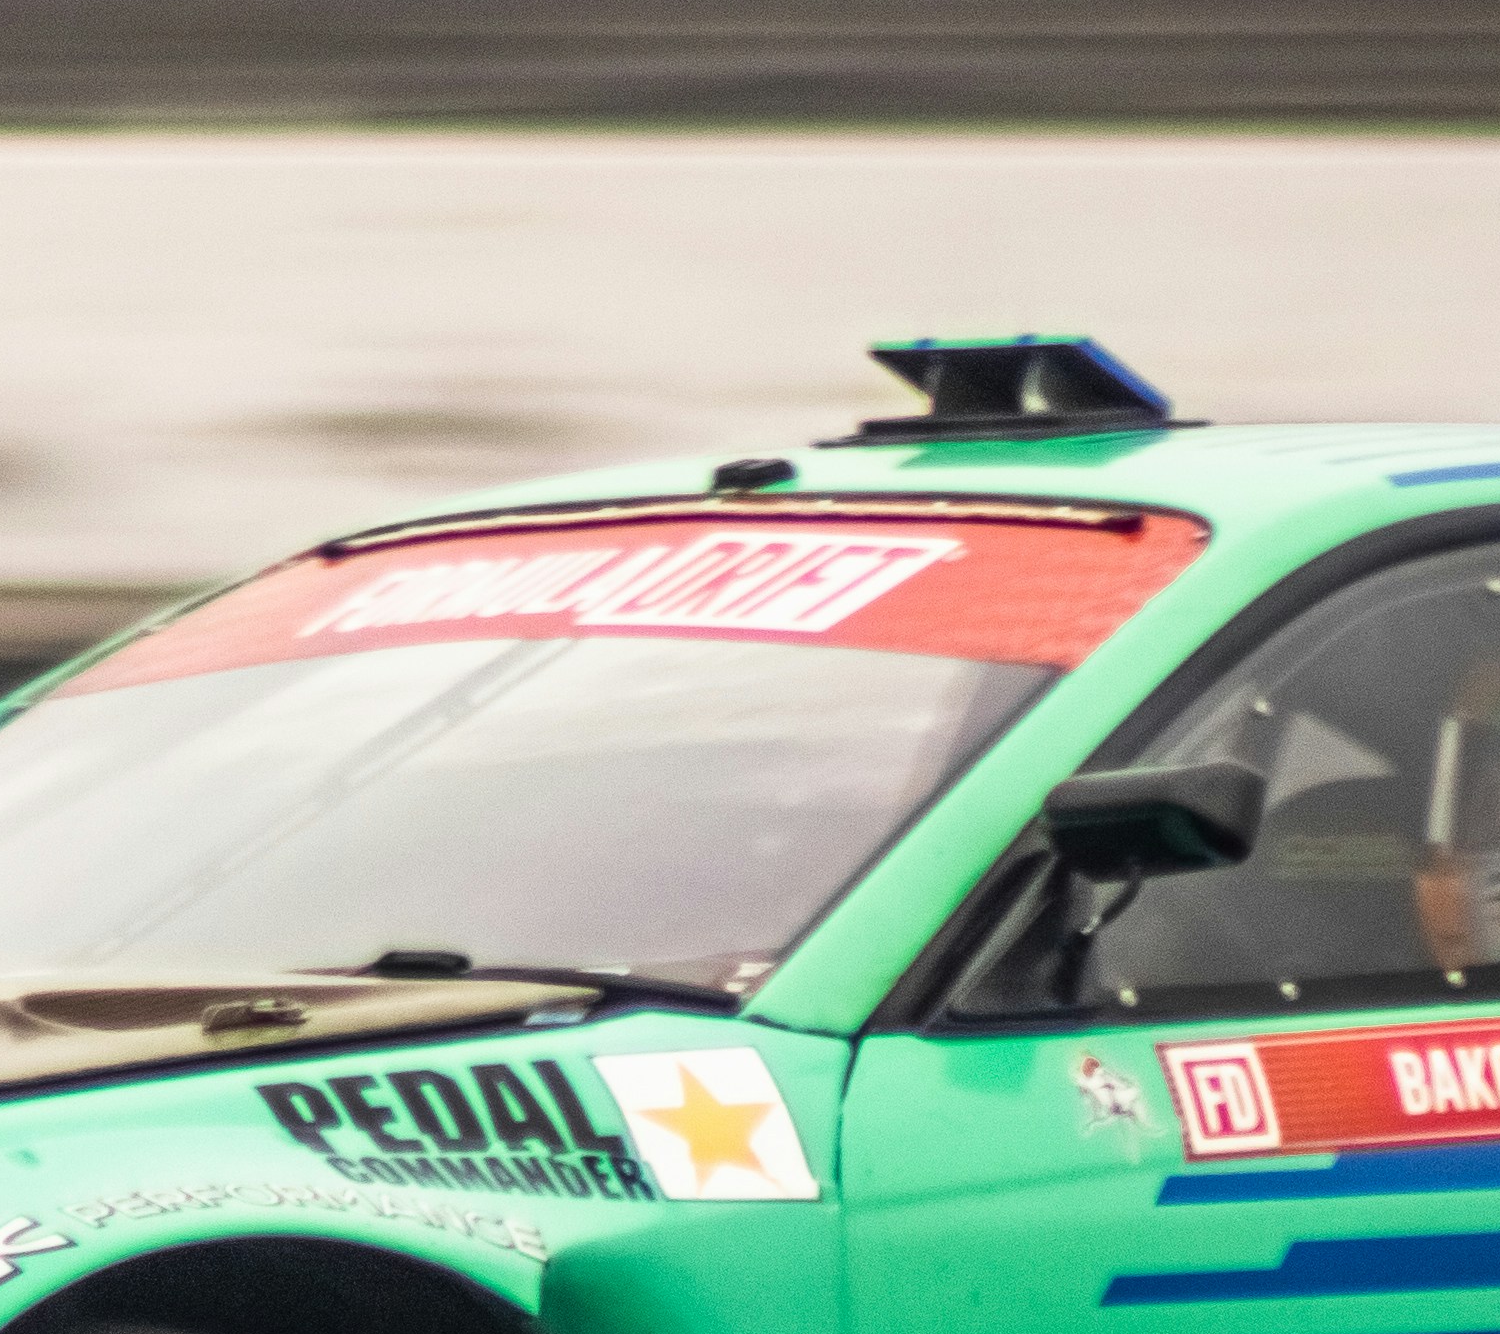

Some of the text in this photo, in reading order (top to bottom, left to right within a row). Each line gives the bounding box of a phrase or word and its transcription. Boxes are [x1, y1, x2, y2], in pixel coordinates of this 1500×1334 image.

[255, 1058, 625, 1155] PEDAL
[323, 1152, 655, 1202] COMMANDER
[61, 1180, 550, 1265] PERFORMANCE
